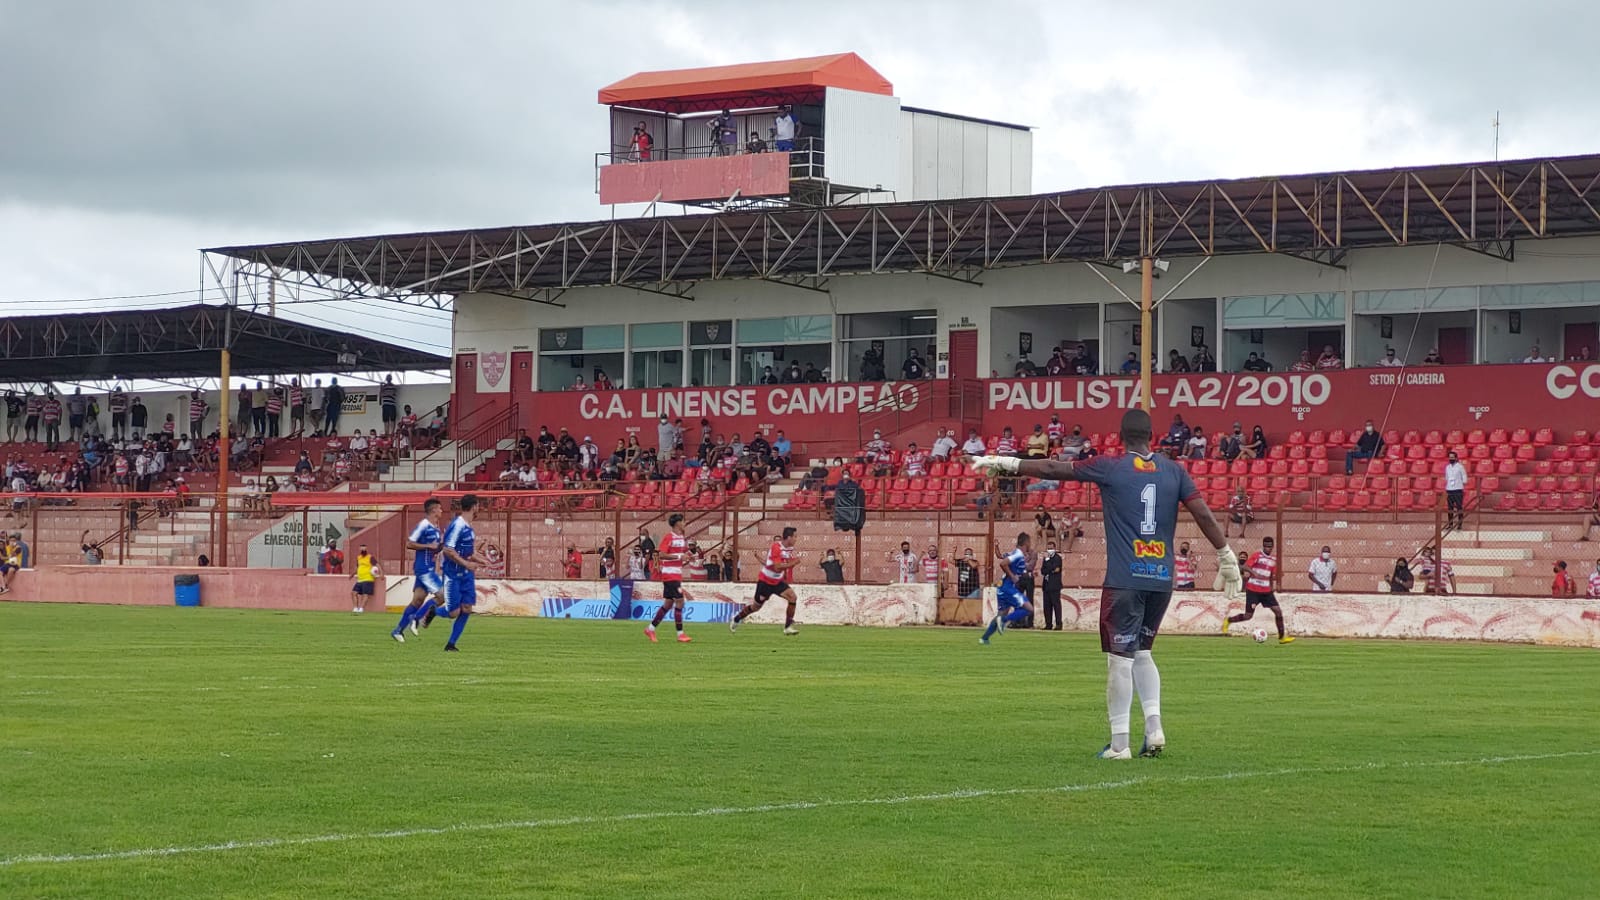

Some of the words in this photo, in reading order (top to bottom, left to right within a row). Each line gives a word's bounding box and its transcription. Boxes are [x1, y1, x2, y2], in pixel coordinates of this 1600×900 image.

[1369, 374, 1395, 385] SETOR
[1406, 373, 1446, 385] CADEIRA
[580, 393, 633, 419] C.A.
[641, 389, 757, 418] LINENSE
[767, 381, 920, 415] CAMPEÃO
[1475, 412, 1482, 420] F
[1140, 483, 1157, 535] 1
[284, 519, 308, 533] SAÍD
[312, 523, 322, 533] DE
[264, 534, 324, 546] EMERGECIA
